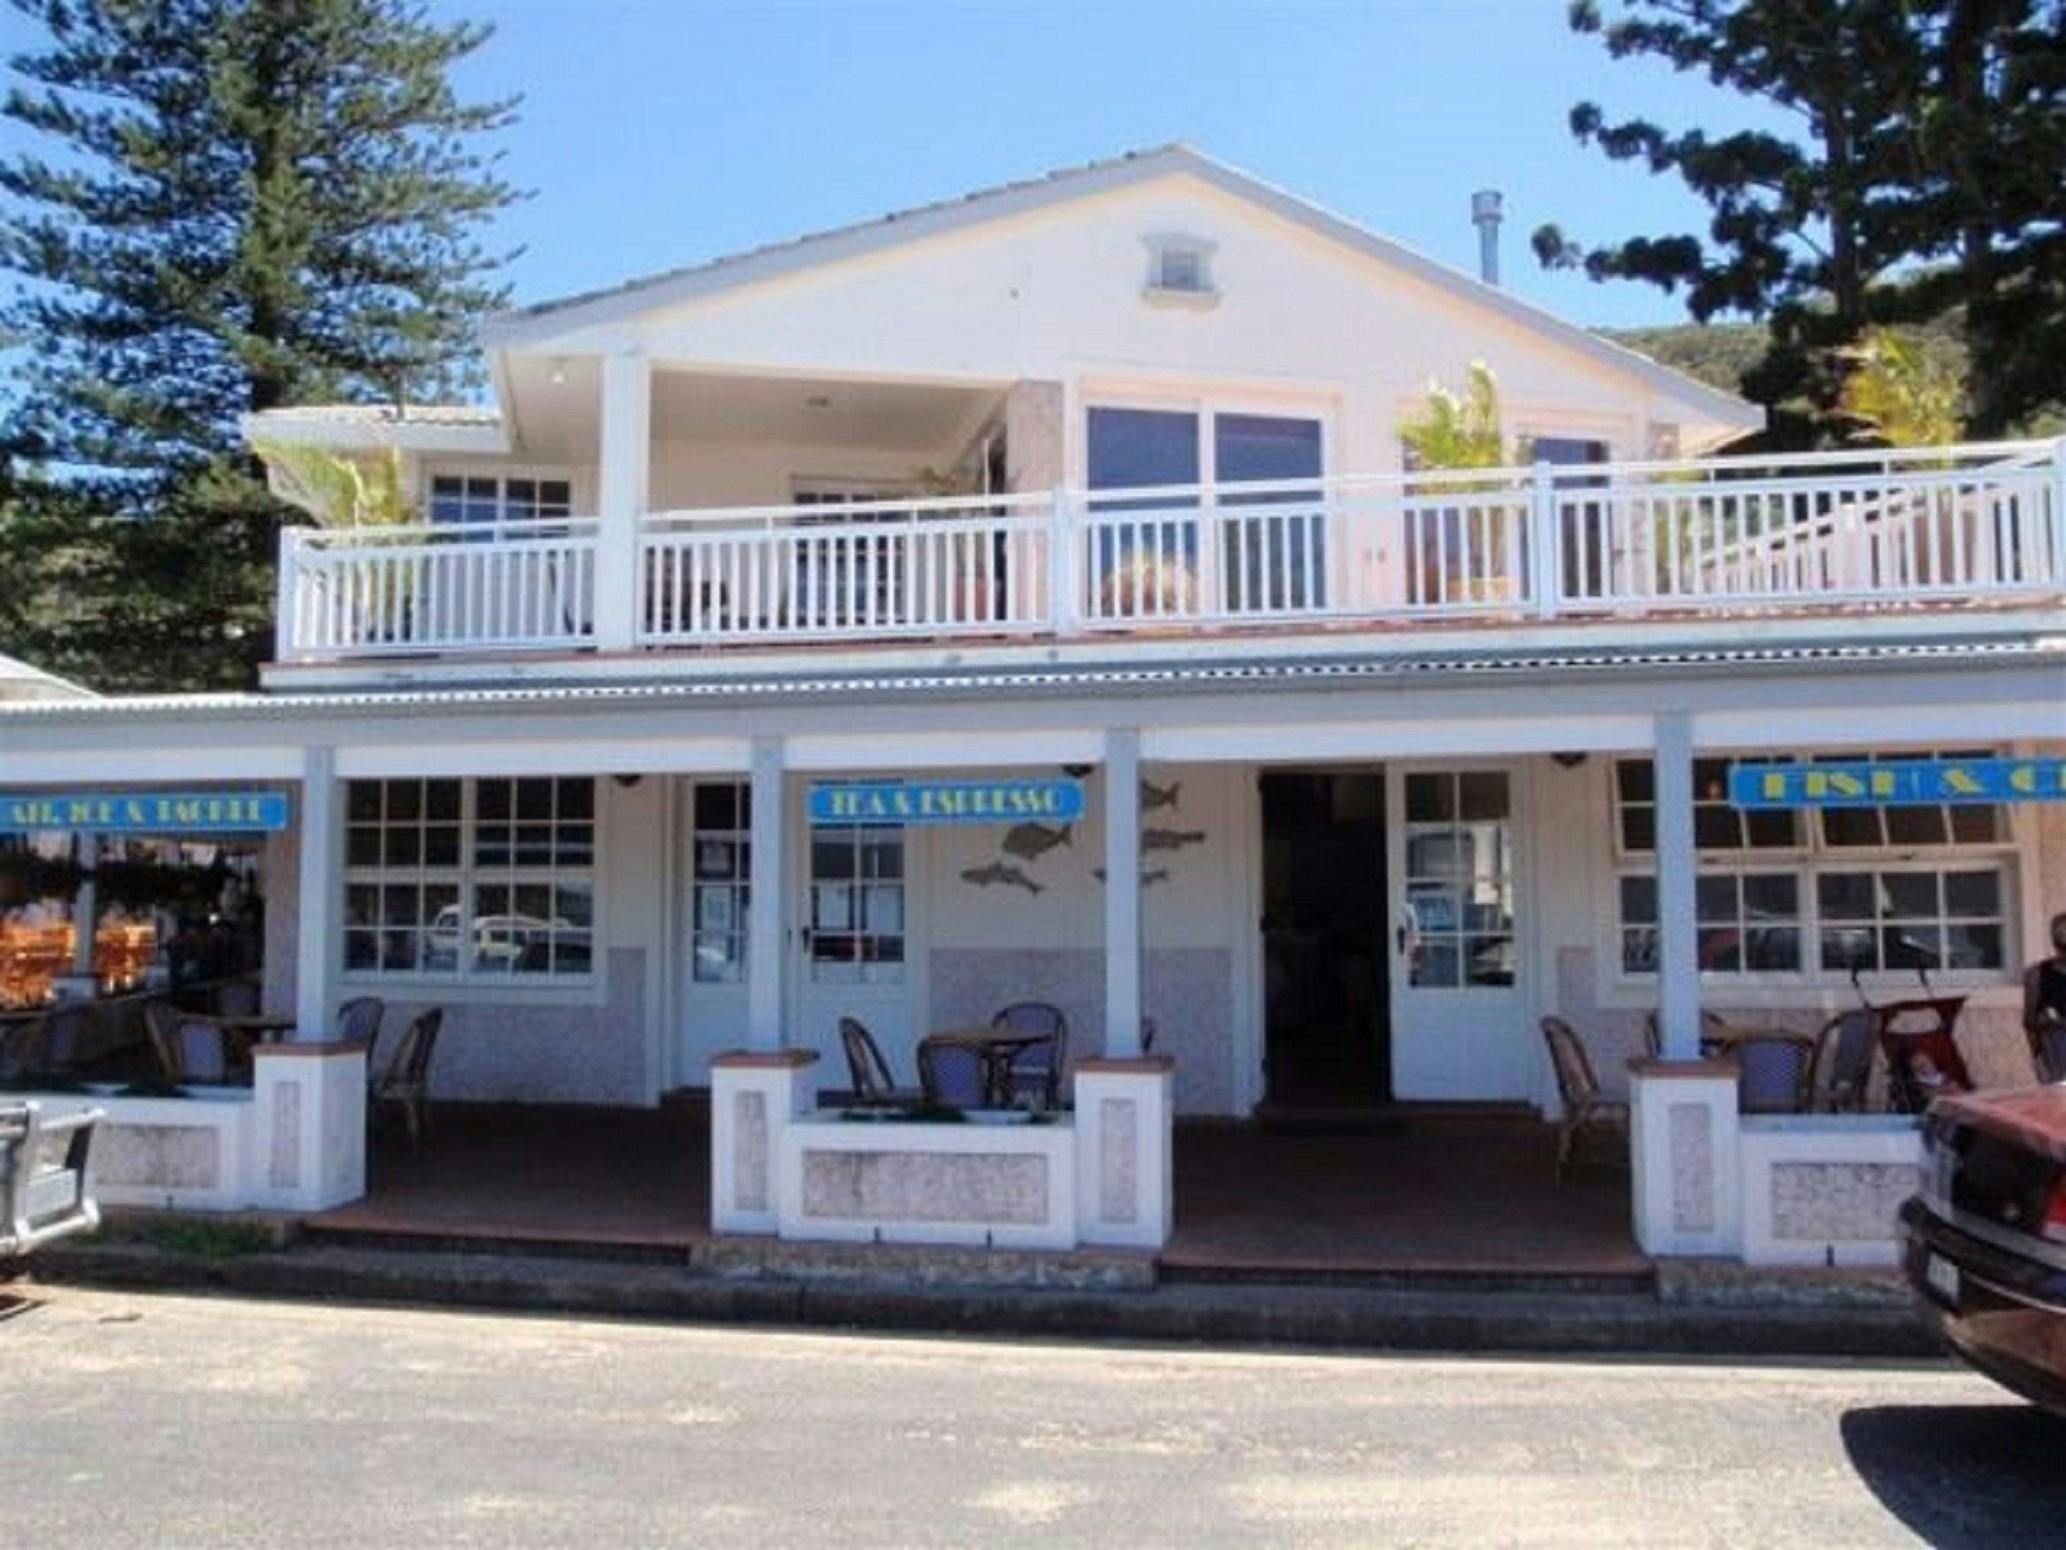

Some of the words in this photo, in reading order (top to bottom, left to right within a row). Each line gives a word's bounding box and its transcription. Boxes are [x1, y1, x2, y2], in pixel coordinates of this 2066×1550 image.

[1762, 771, 1917, 800] FISH
[1940, 769, 1985, 794] &
[2008, 767, 2066, 794] C
